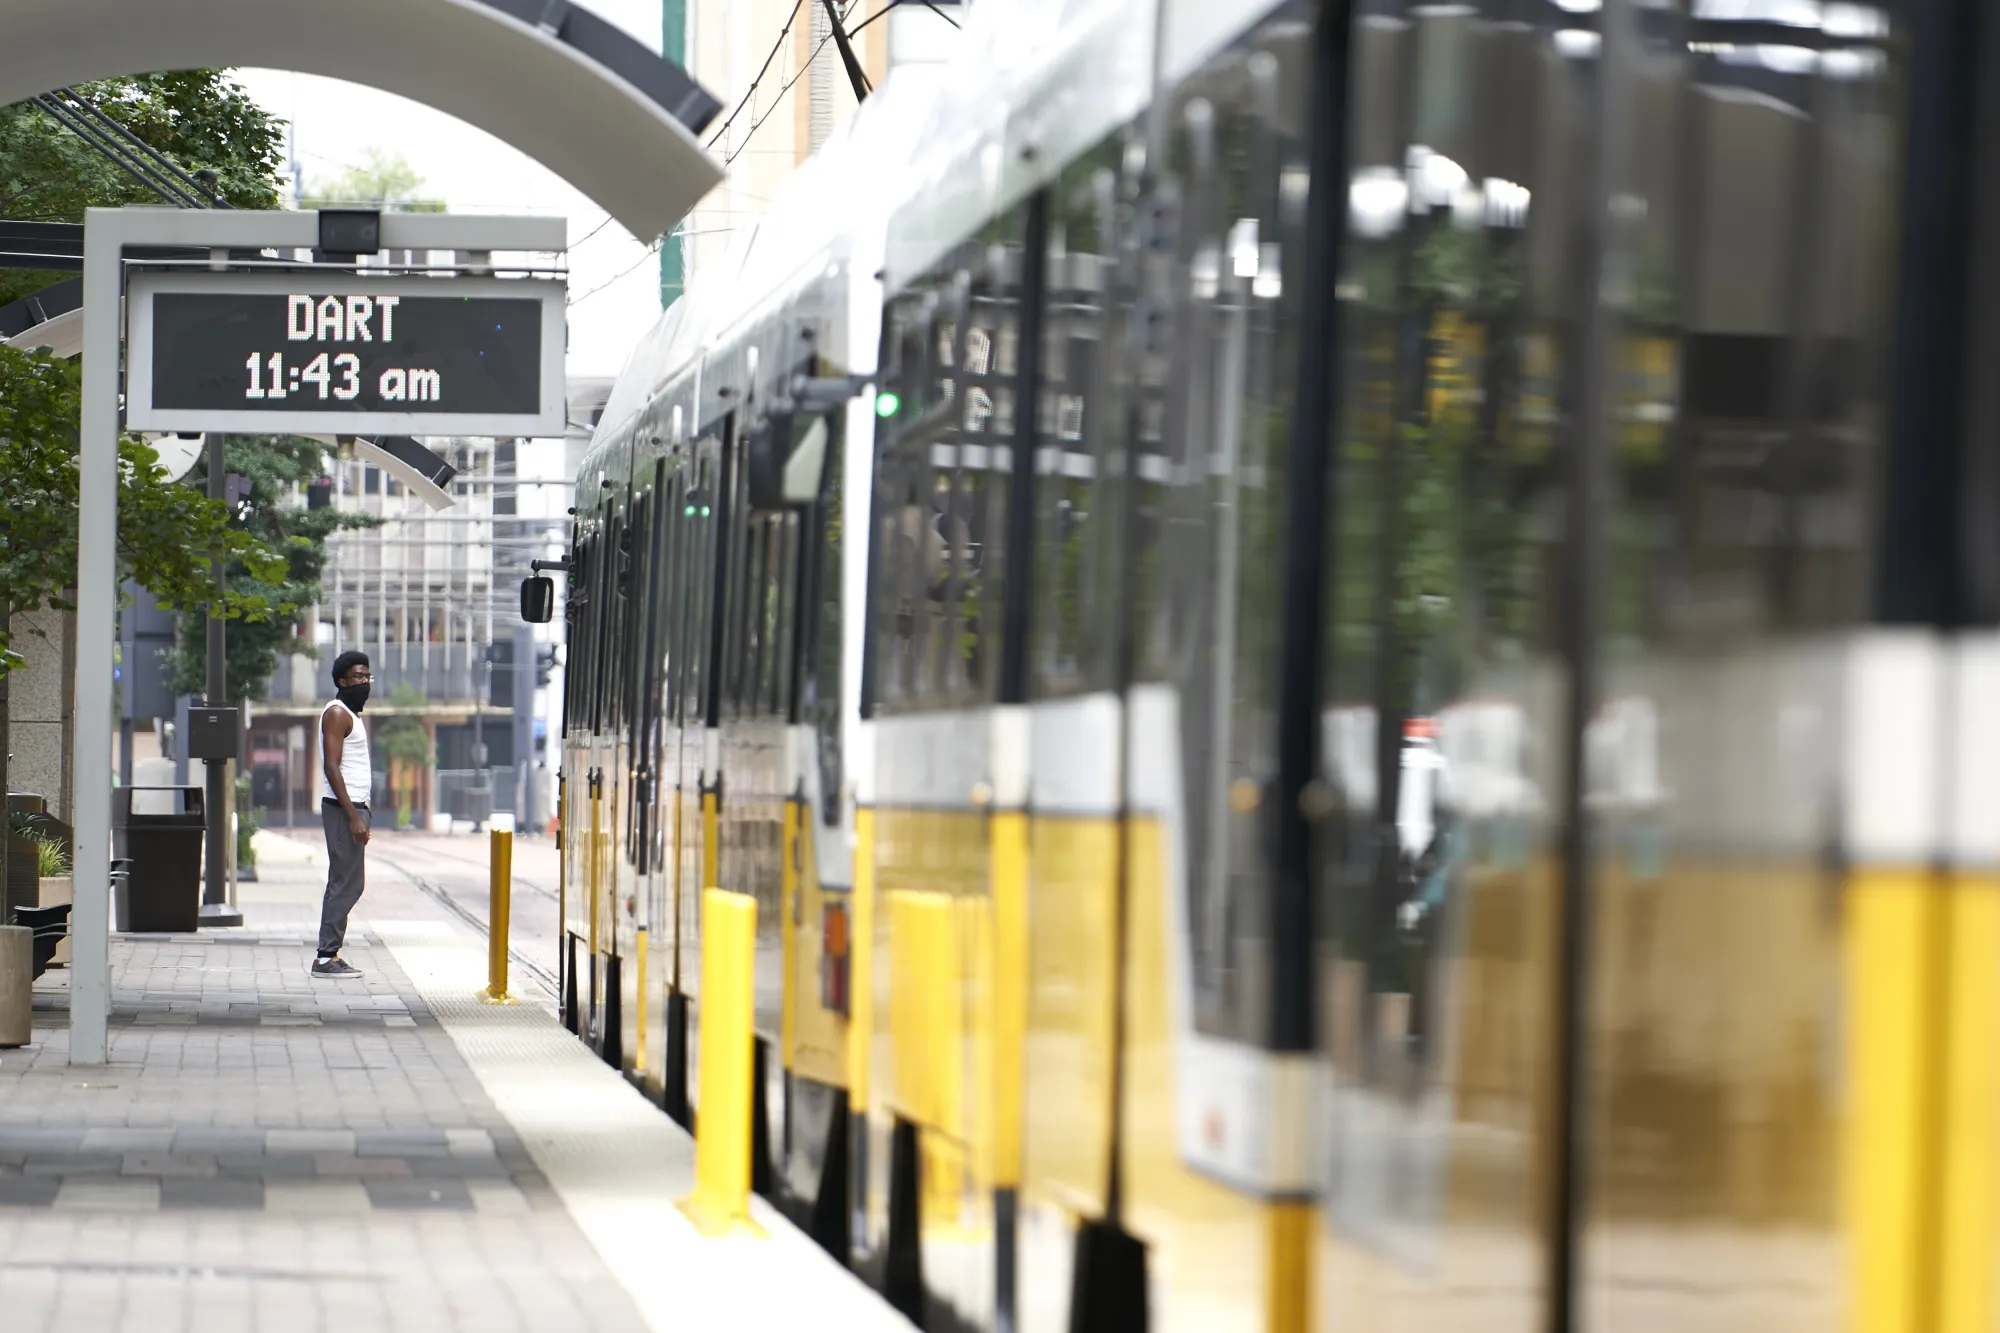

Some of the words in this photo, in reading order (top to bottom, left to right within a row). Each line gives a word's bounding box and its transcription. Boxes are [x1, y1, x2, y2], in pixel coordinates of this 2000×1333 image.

[287, 295, 400, 342] DART
[245, 352, 360, 400] 11:43
[379, 367, 441, 402] am
